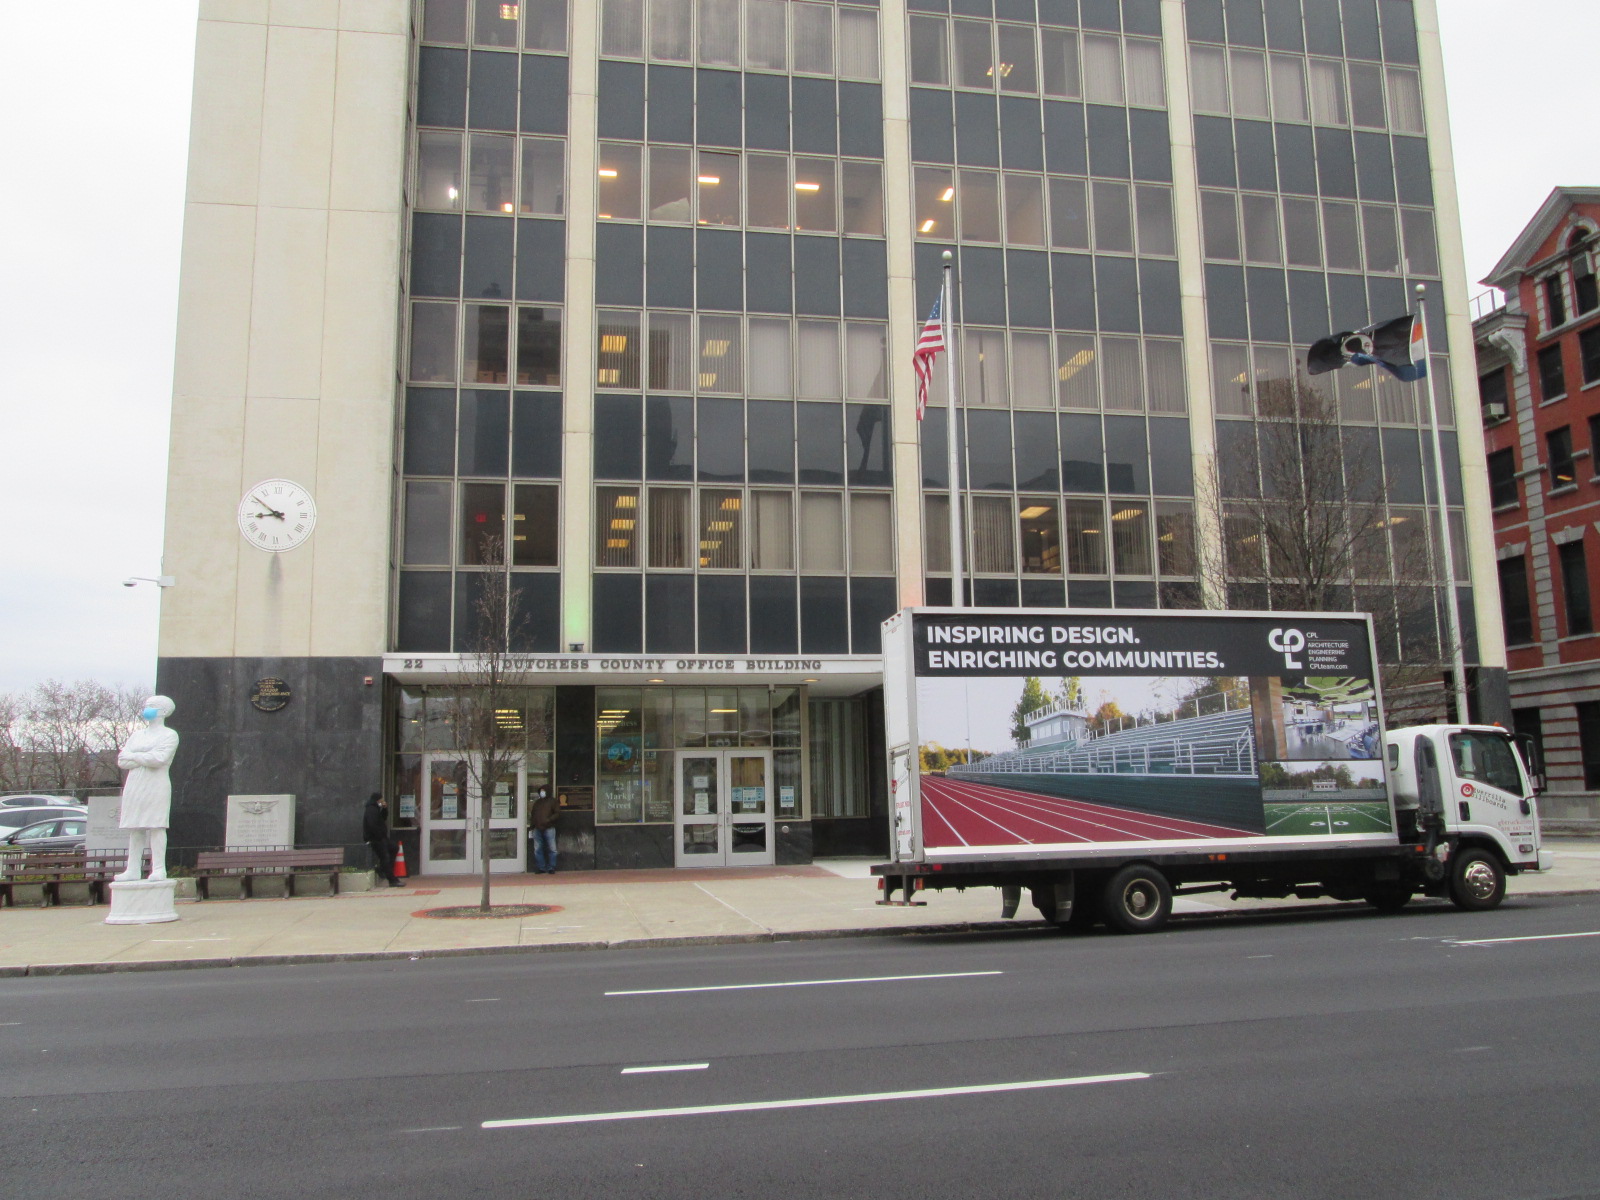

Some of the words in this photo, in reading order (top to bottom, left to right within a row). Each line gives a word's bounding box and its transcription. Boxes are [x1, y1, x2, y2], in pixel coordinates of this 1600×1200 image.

[927, 626, 1044, 643] INSPIRING
[1051, 627, 1141, 644] DESIGN.
[403, 659, 423, 669] 22
[502, 659, 589, 669] DUTCHESS
[601, 659, 665, 669] COUNTY
[676, 659, 735, 669] OFFICE
[746, 659, 822, 670] BUILDING
[928, 650, 1056, 668] ENRICHING
[1063, 651, 1225, 668] COMMUNITIES.
